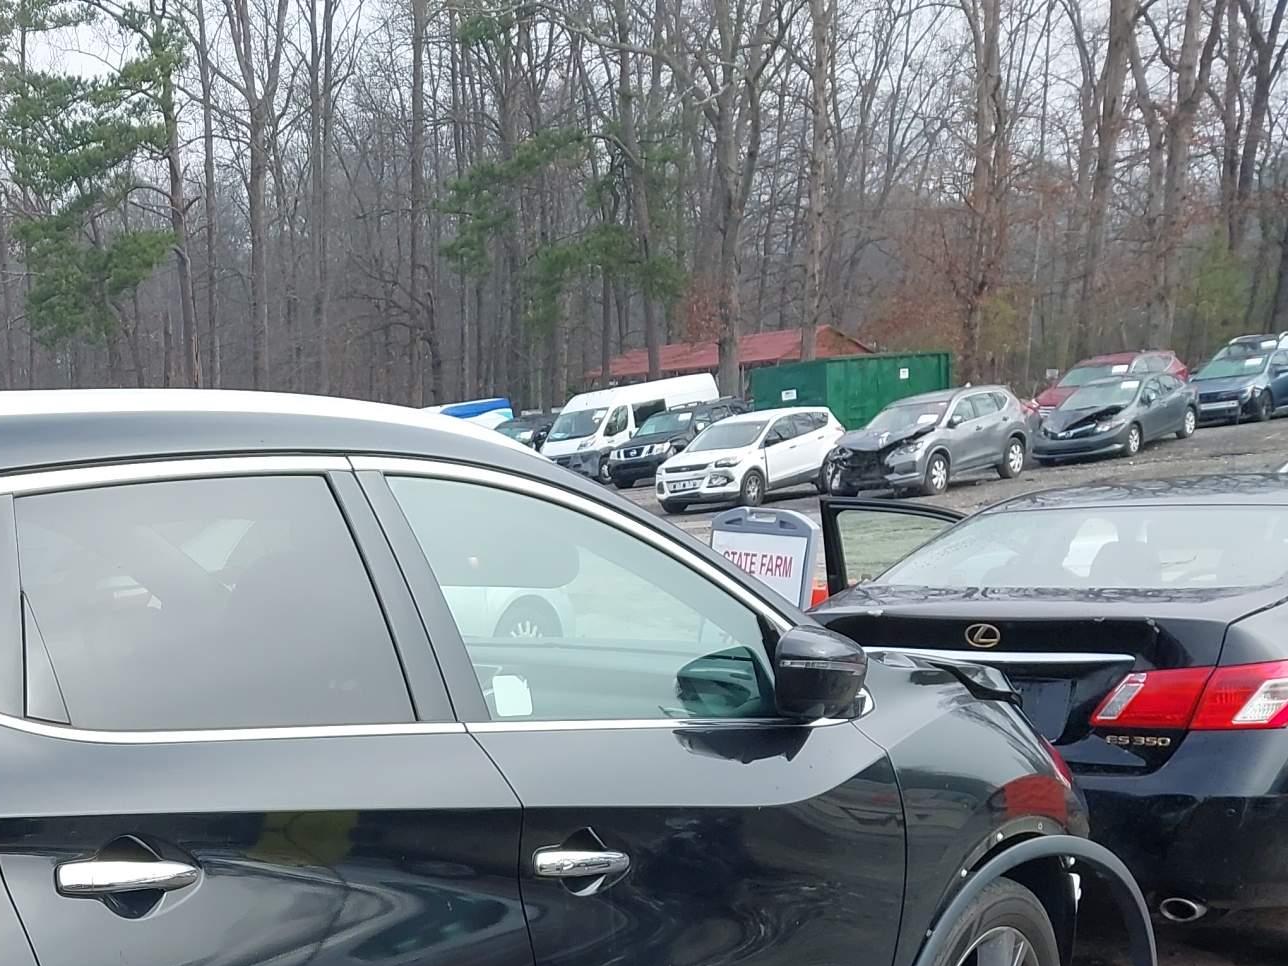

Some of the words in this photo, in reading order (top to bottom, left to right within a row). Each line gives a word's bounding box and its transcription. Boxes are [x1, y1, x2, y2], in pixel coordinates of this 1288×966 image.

[759, 554, 793, 577] FARM
[1106, 735, 1130, 745] ES
[1133, 736, 1171, 746] 350
